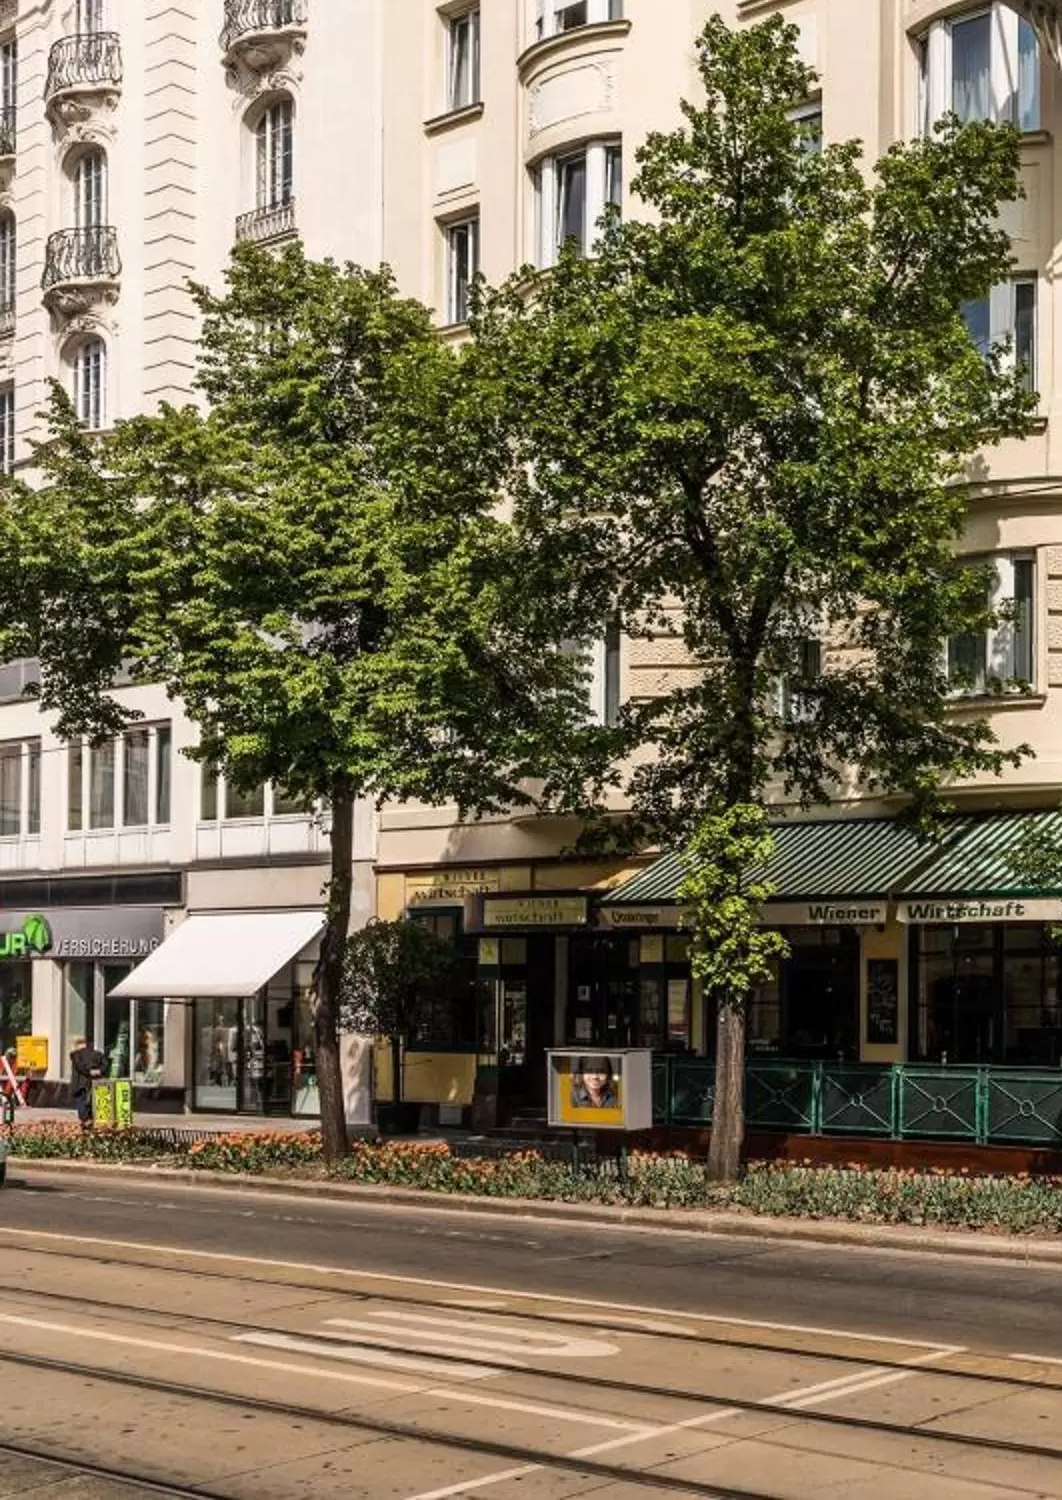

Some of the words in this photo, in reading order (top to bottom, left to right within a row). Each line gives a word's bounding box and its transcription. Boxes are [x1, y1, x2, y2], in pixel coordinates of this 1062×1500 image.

[808, 905, 881, 920] Wiener
[907, 901, 1025, 919] Wirtschaft
[54, 937, 161, 956] VERSICHERUNG
